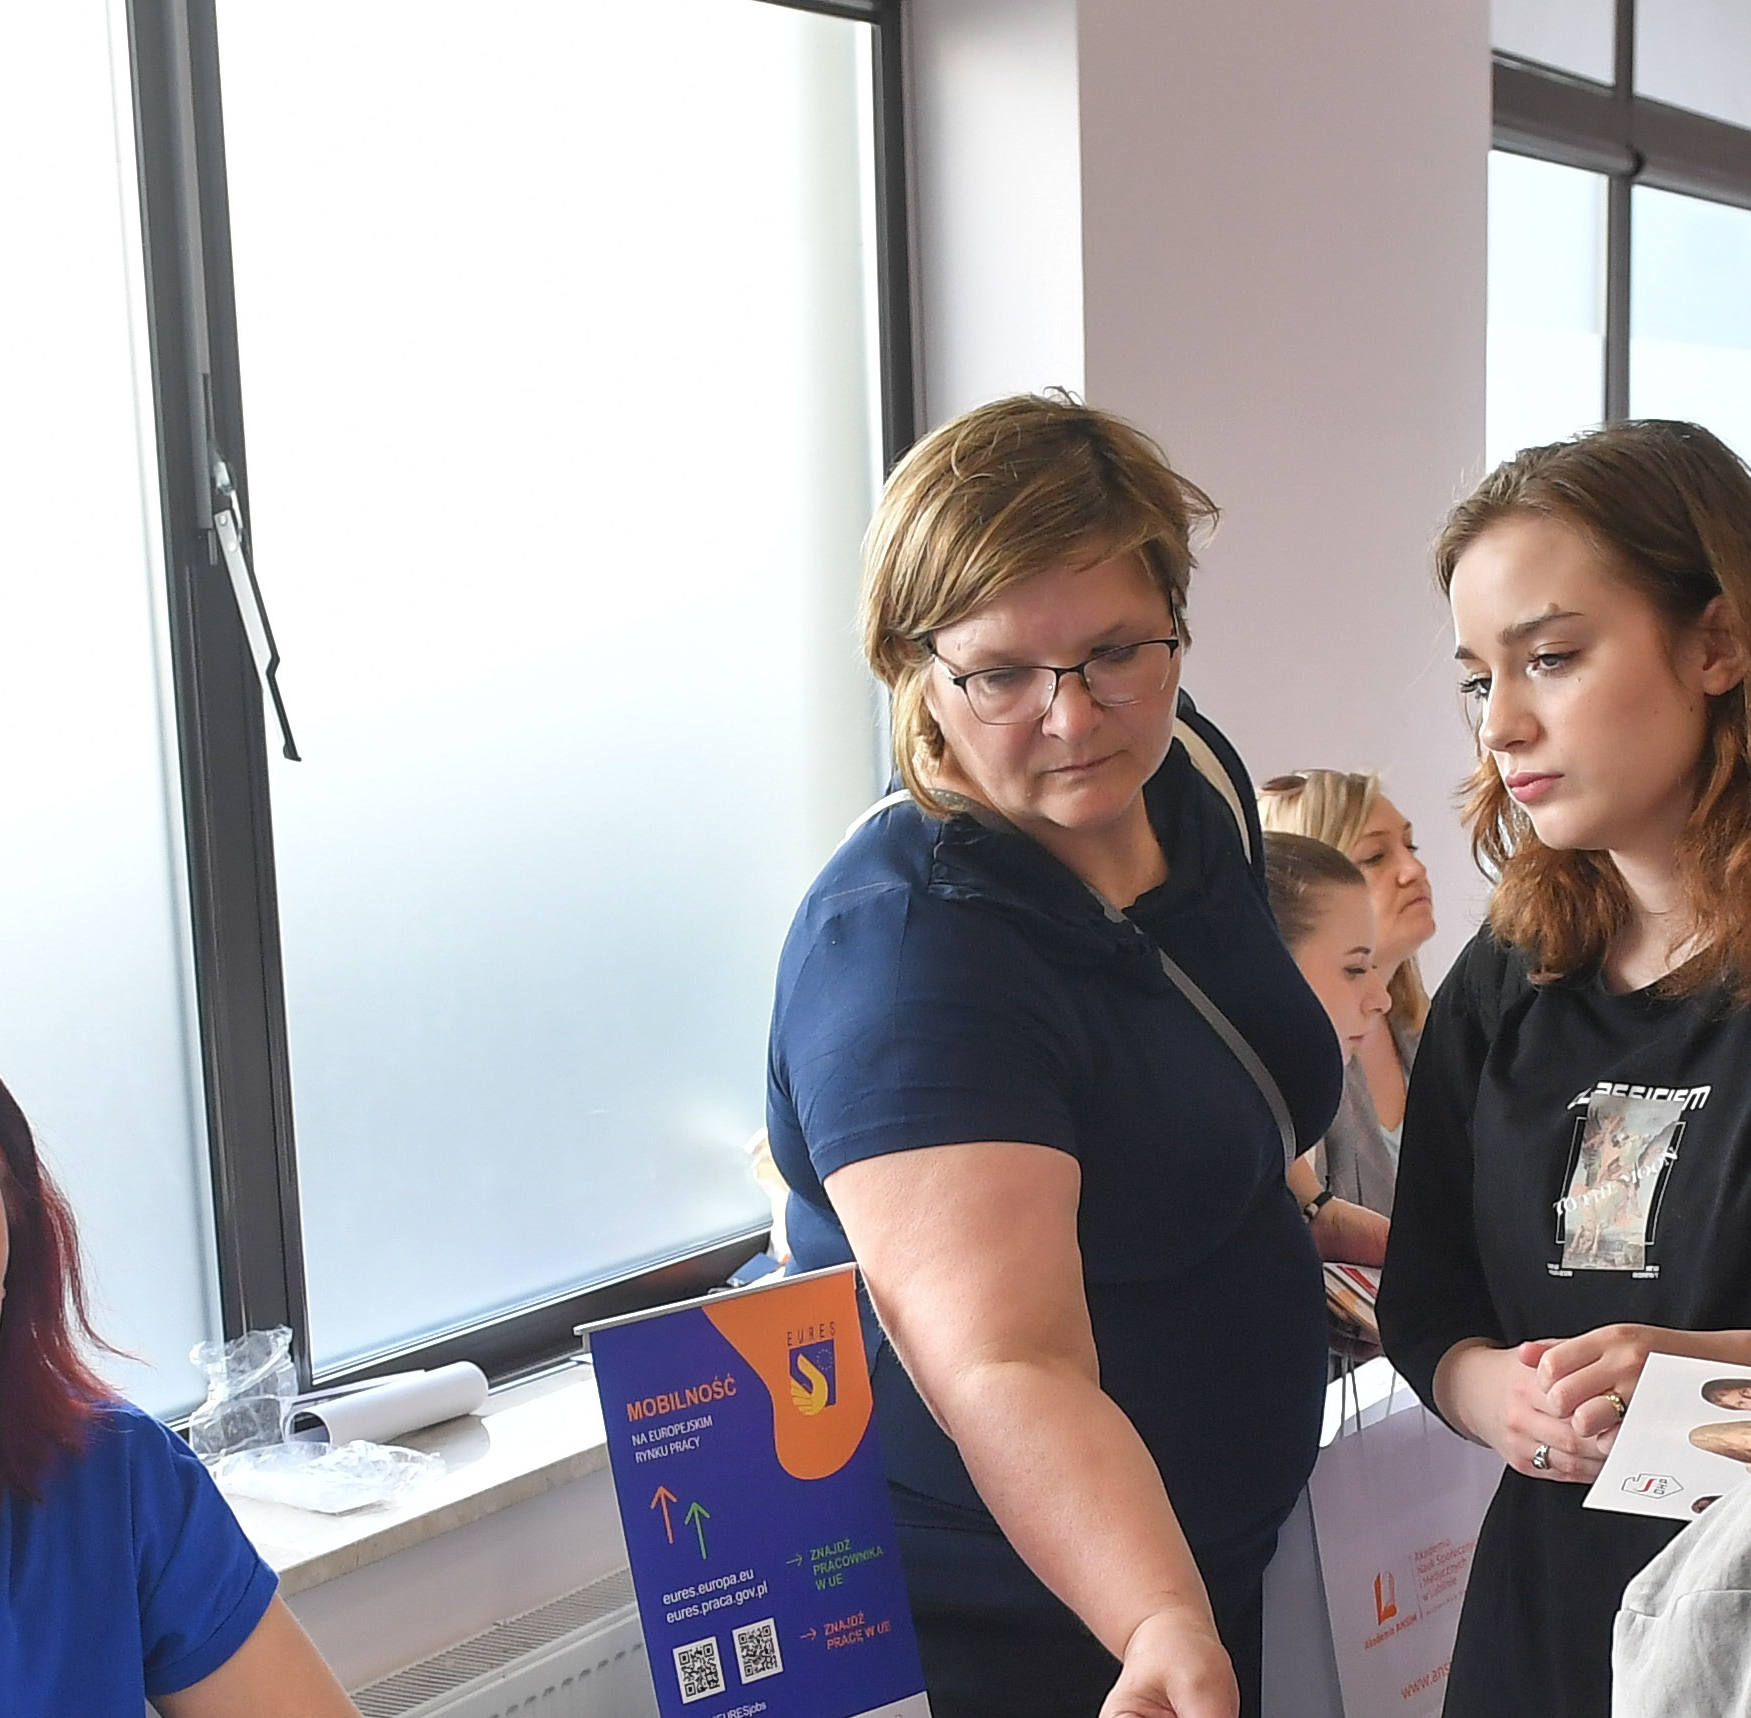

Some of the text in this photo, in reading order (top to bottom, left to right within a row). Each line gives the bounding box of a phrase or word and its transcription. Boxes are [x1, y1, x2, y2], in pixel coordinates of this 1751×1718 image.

[787, 1321, 837, 1346] EURES
[626, 1373, 737, 1422] MOBILNOŚĆ
[632, 1415, 713, 1447] NA EUROPEJSKIM
[635, 1436, 701, 1464] RYNKU PRACY
[813, 1545, 884, 1575] PRACOWNIKA
[662, 1568, 754, 1605] eures.europa.eu
[815, 1574, 843, 1591] W UE
[666, 1581, 768, 1624] eures.praca.gov.pl
[865, 1625, 877, 1638] W
